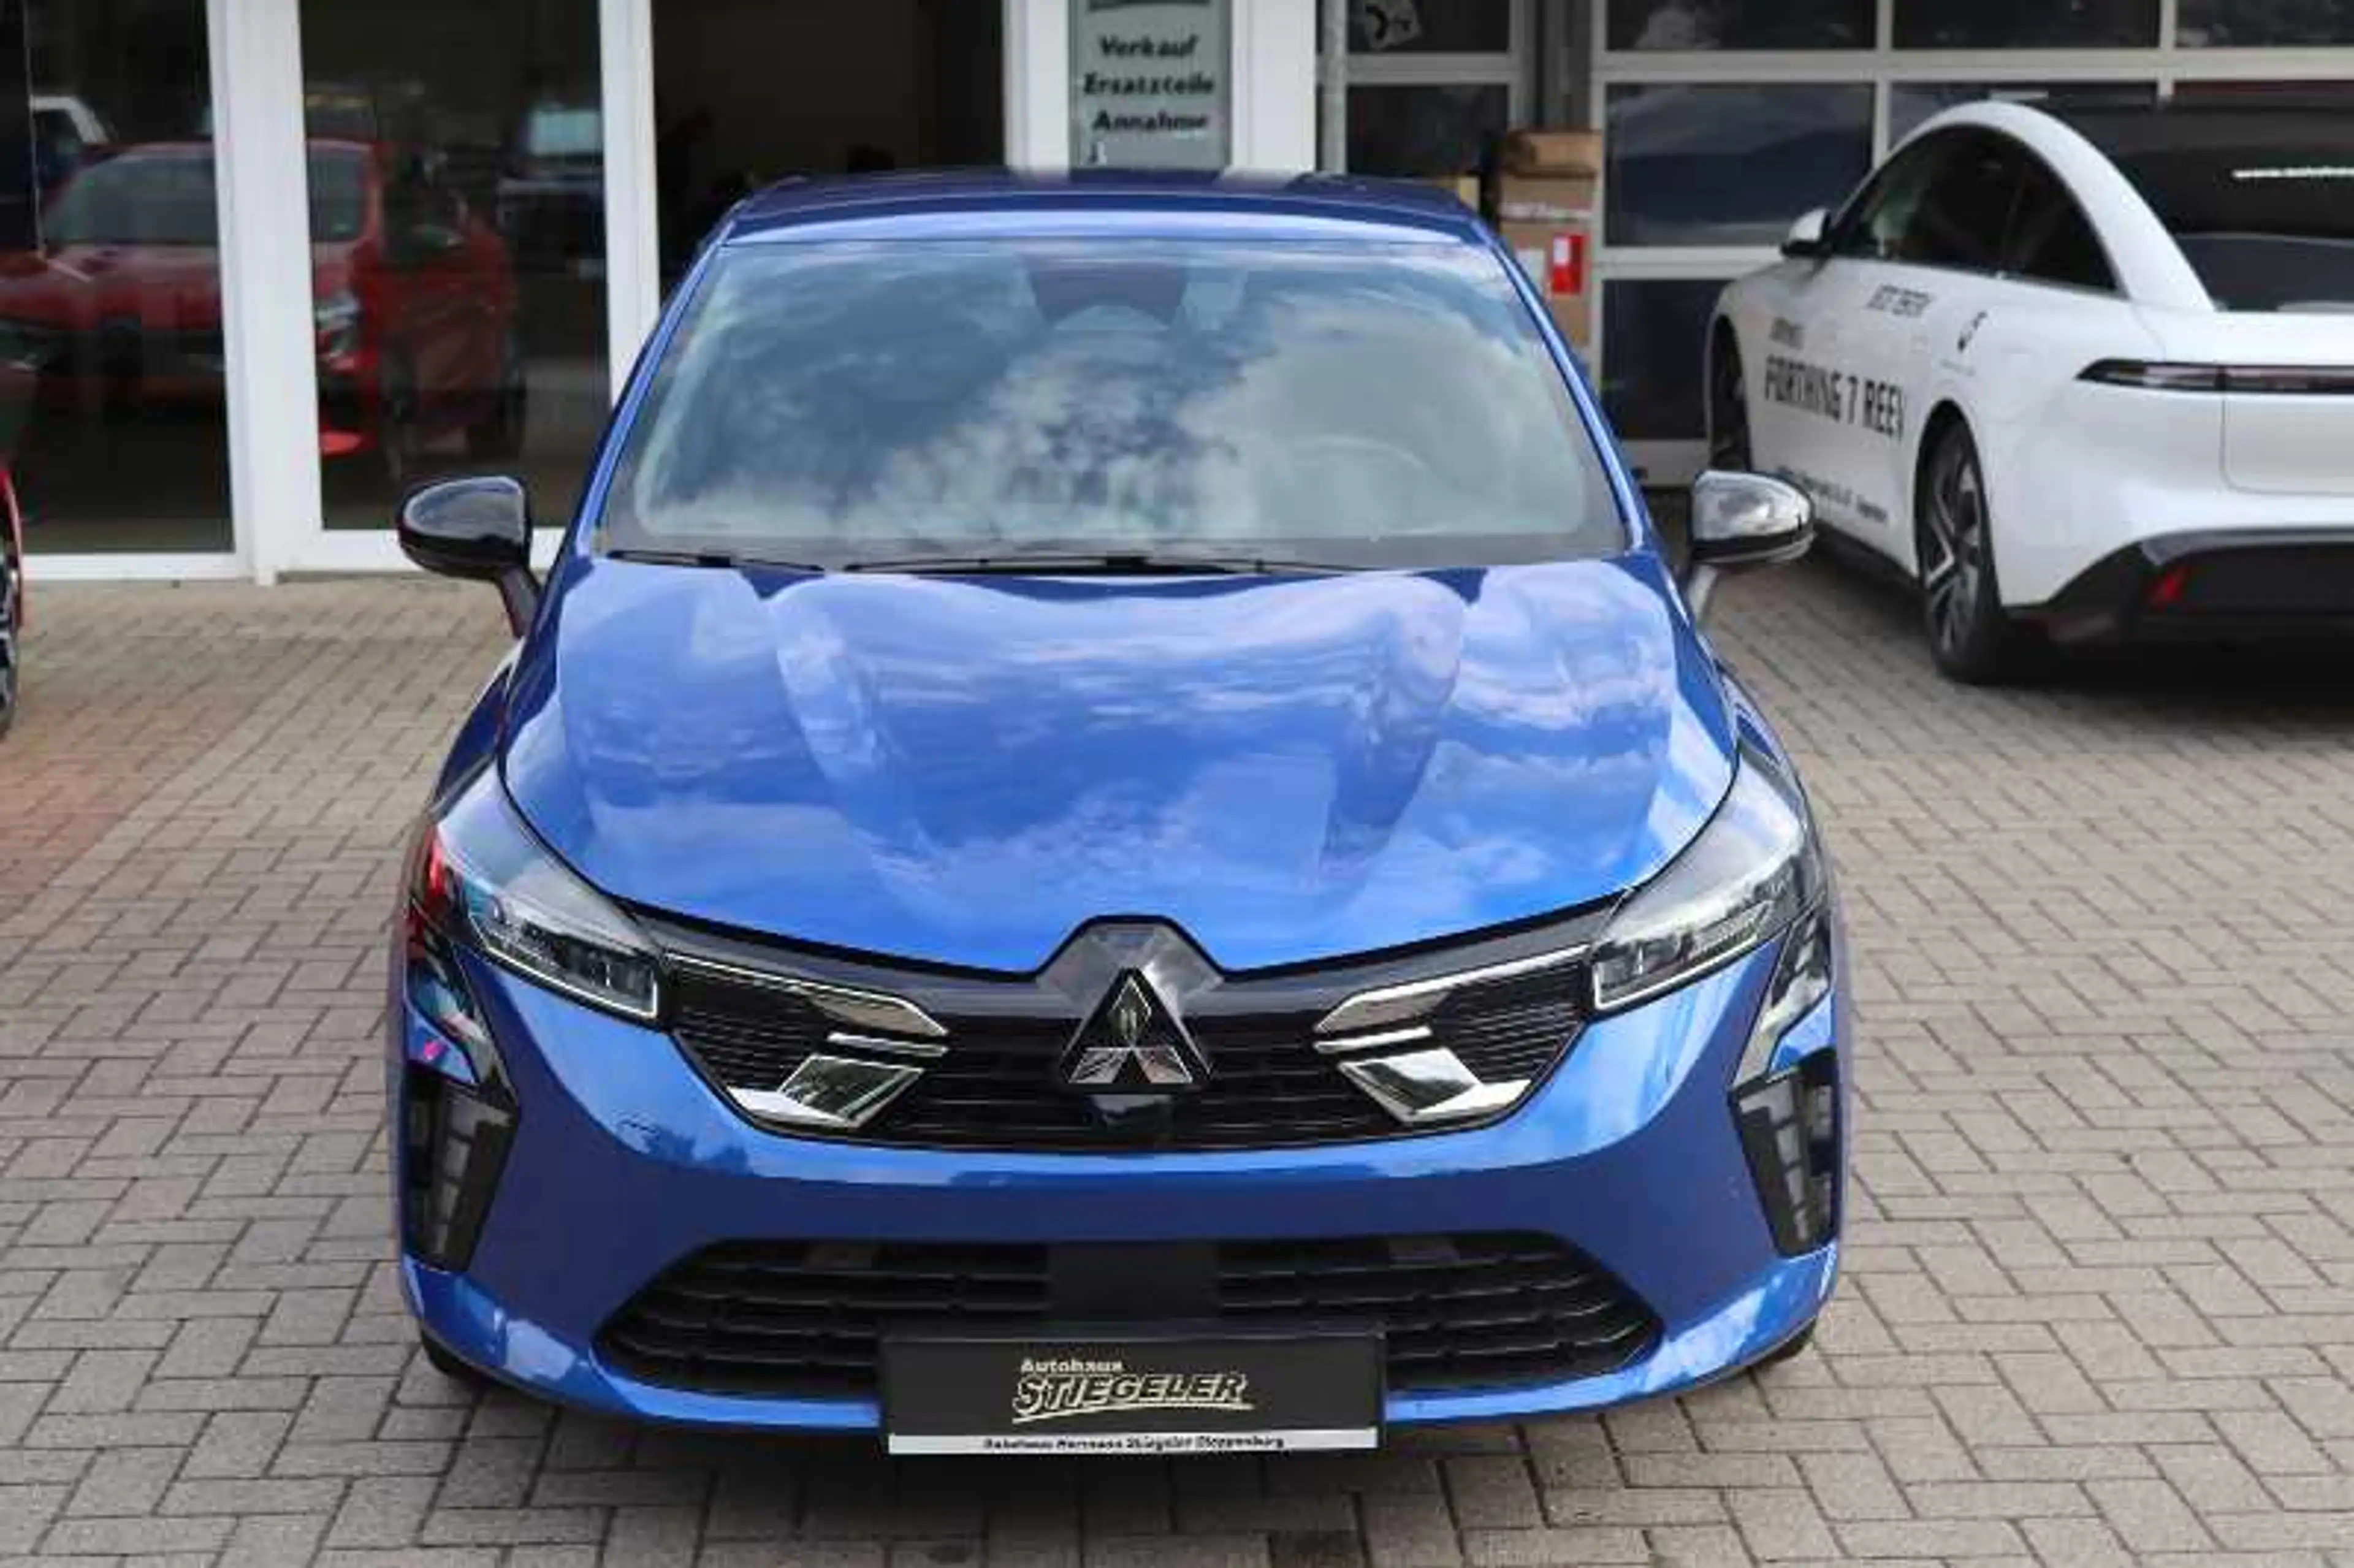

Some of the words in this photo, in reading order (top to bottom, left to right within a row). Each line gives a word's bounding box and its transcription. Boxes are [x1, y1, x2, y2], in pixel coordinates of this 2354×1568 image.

[1099, 33, 1200, 58] Verkauf
[1083, 70, 1214, 95] Ersatzteile
[1091, 108, 1207, 131] Annahme
[1020, 1357, 1124, 1373] Autohaus
[1012, 1371, 1249, 1417] STIEGELER
